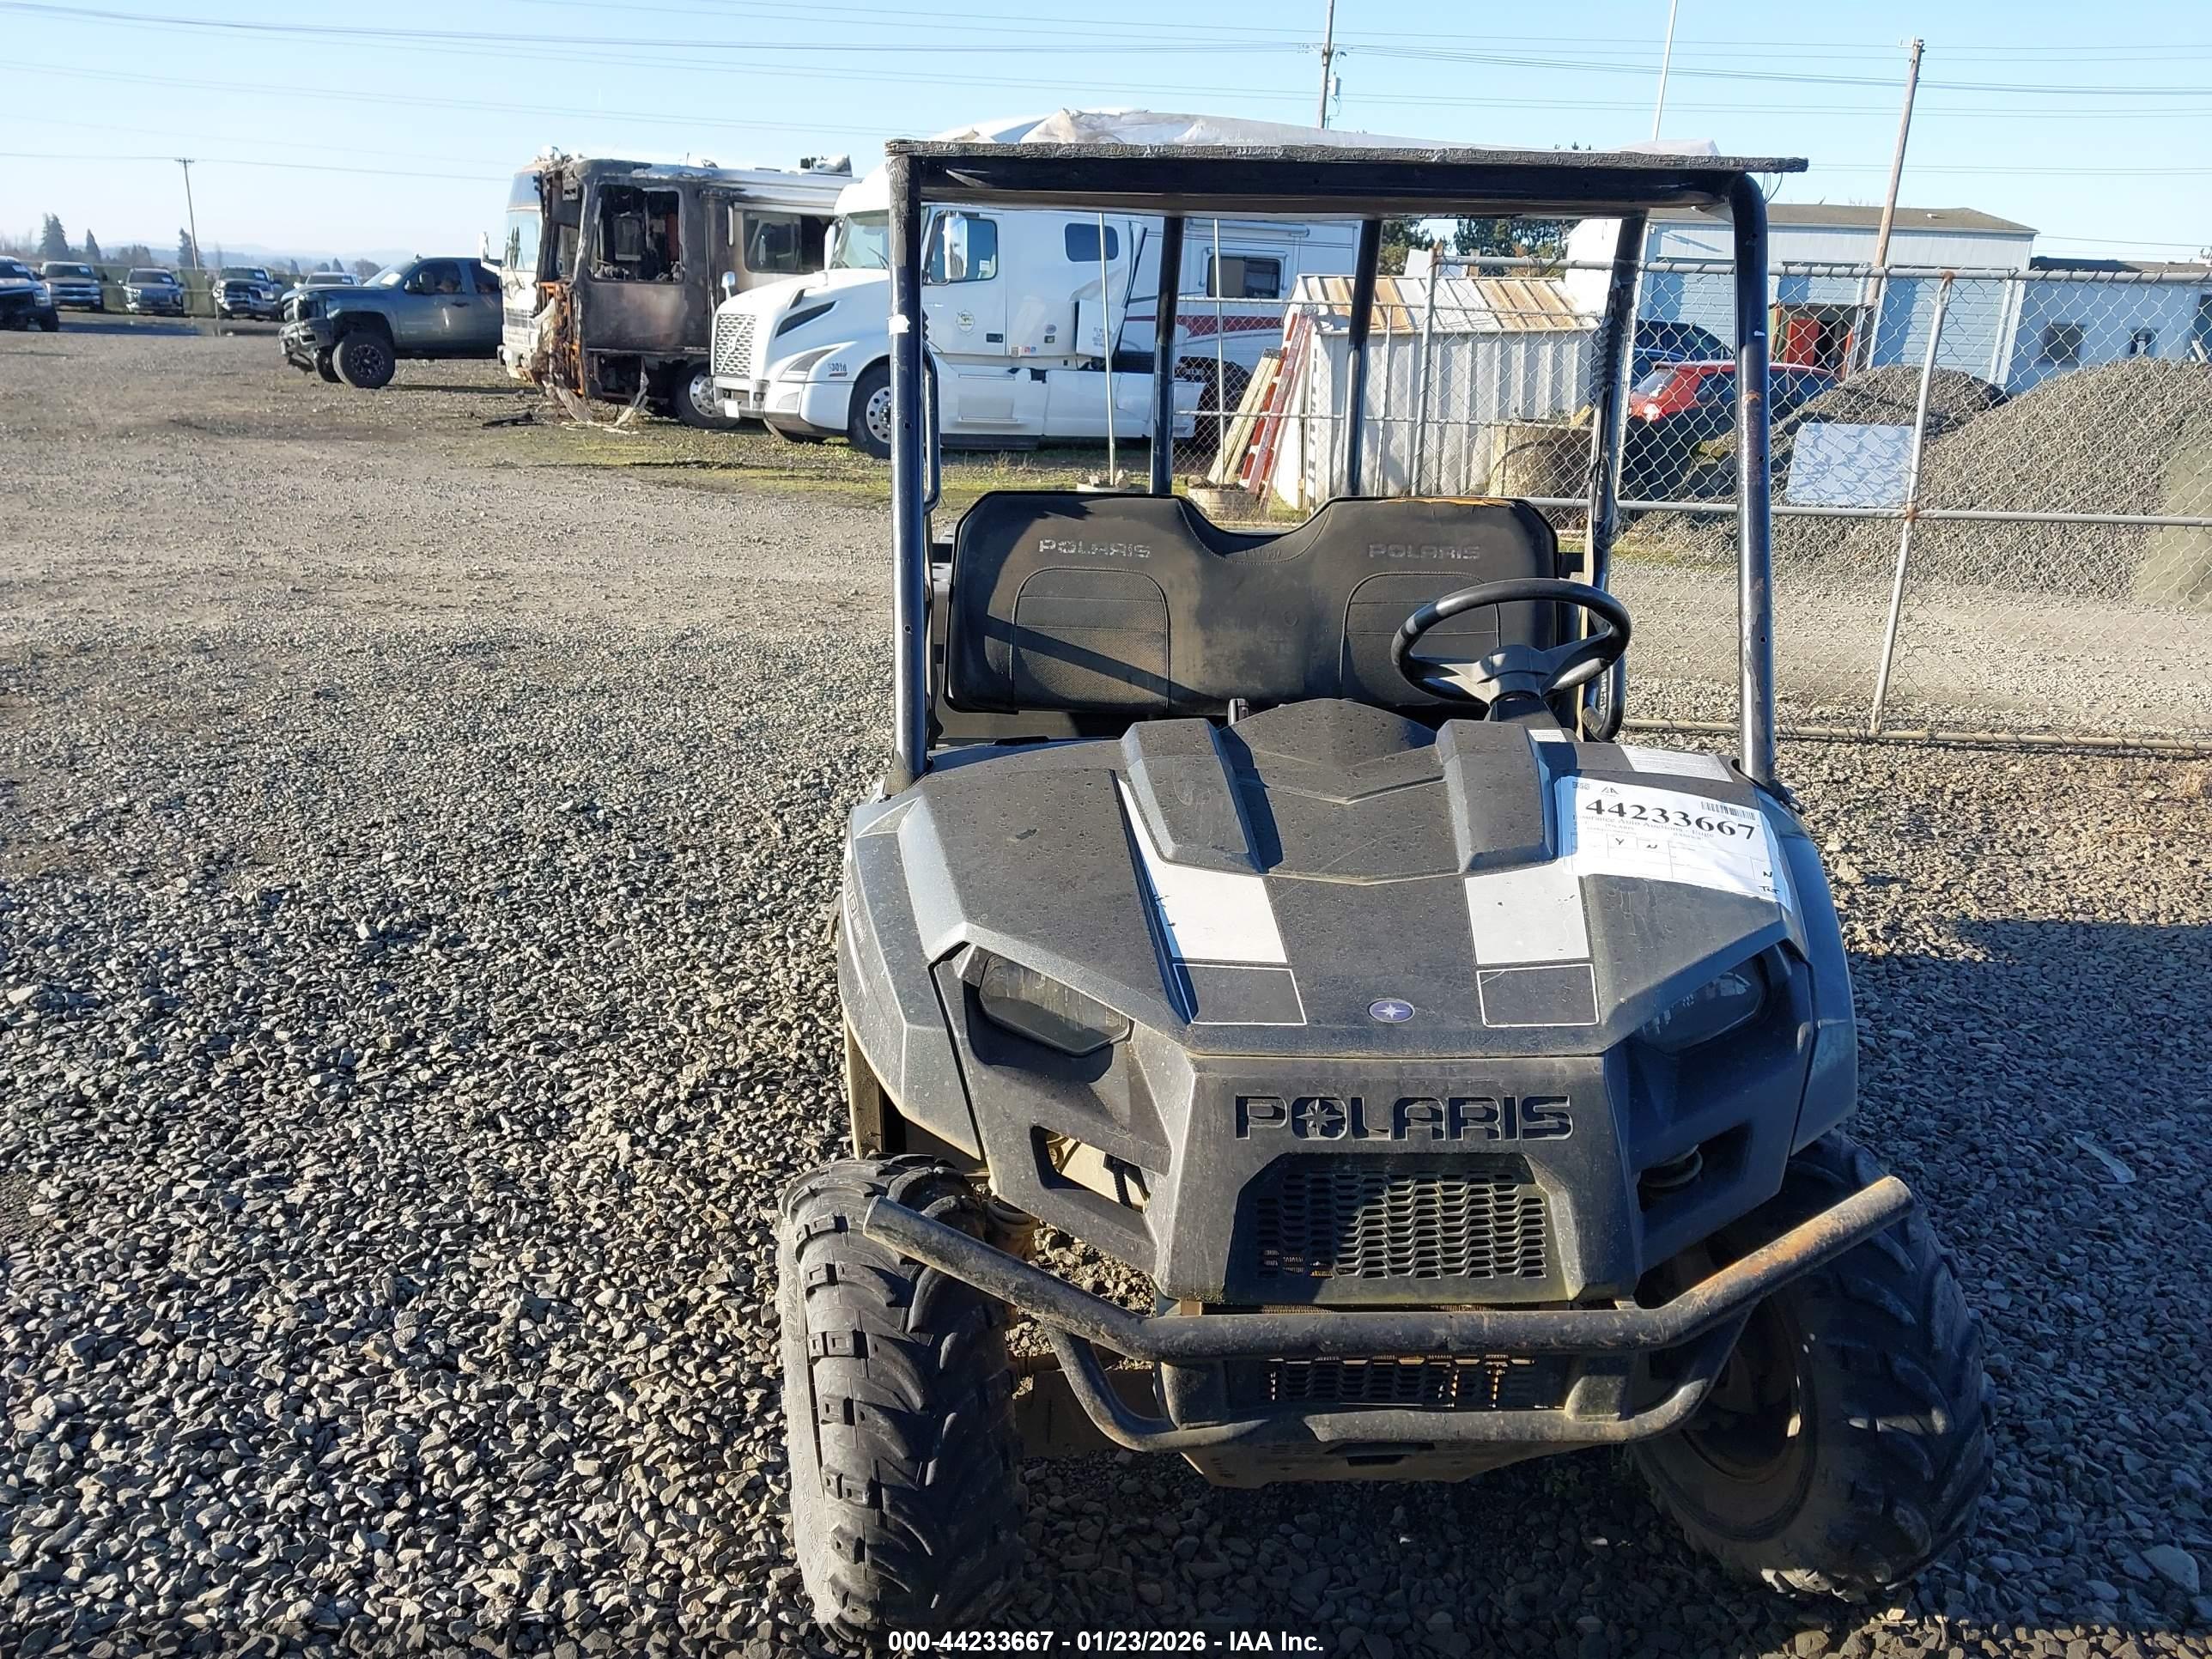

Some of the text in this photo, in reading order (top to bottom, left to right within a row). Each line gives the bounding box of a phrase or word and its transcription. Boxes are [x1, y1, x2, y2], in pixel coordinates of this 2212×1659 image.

[1039, 538, 1151, 558] POLARIS
[1369, 543, 1480, 560] POLARIS
[1586, 799, 1755, 840] 44233667
[1236, 1095, 1573, 1140] POLARIS
